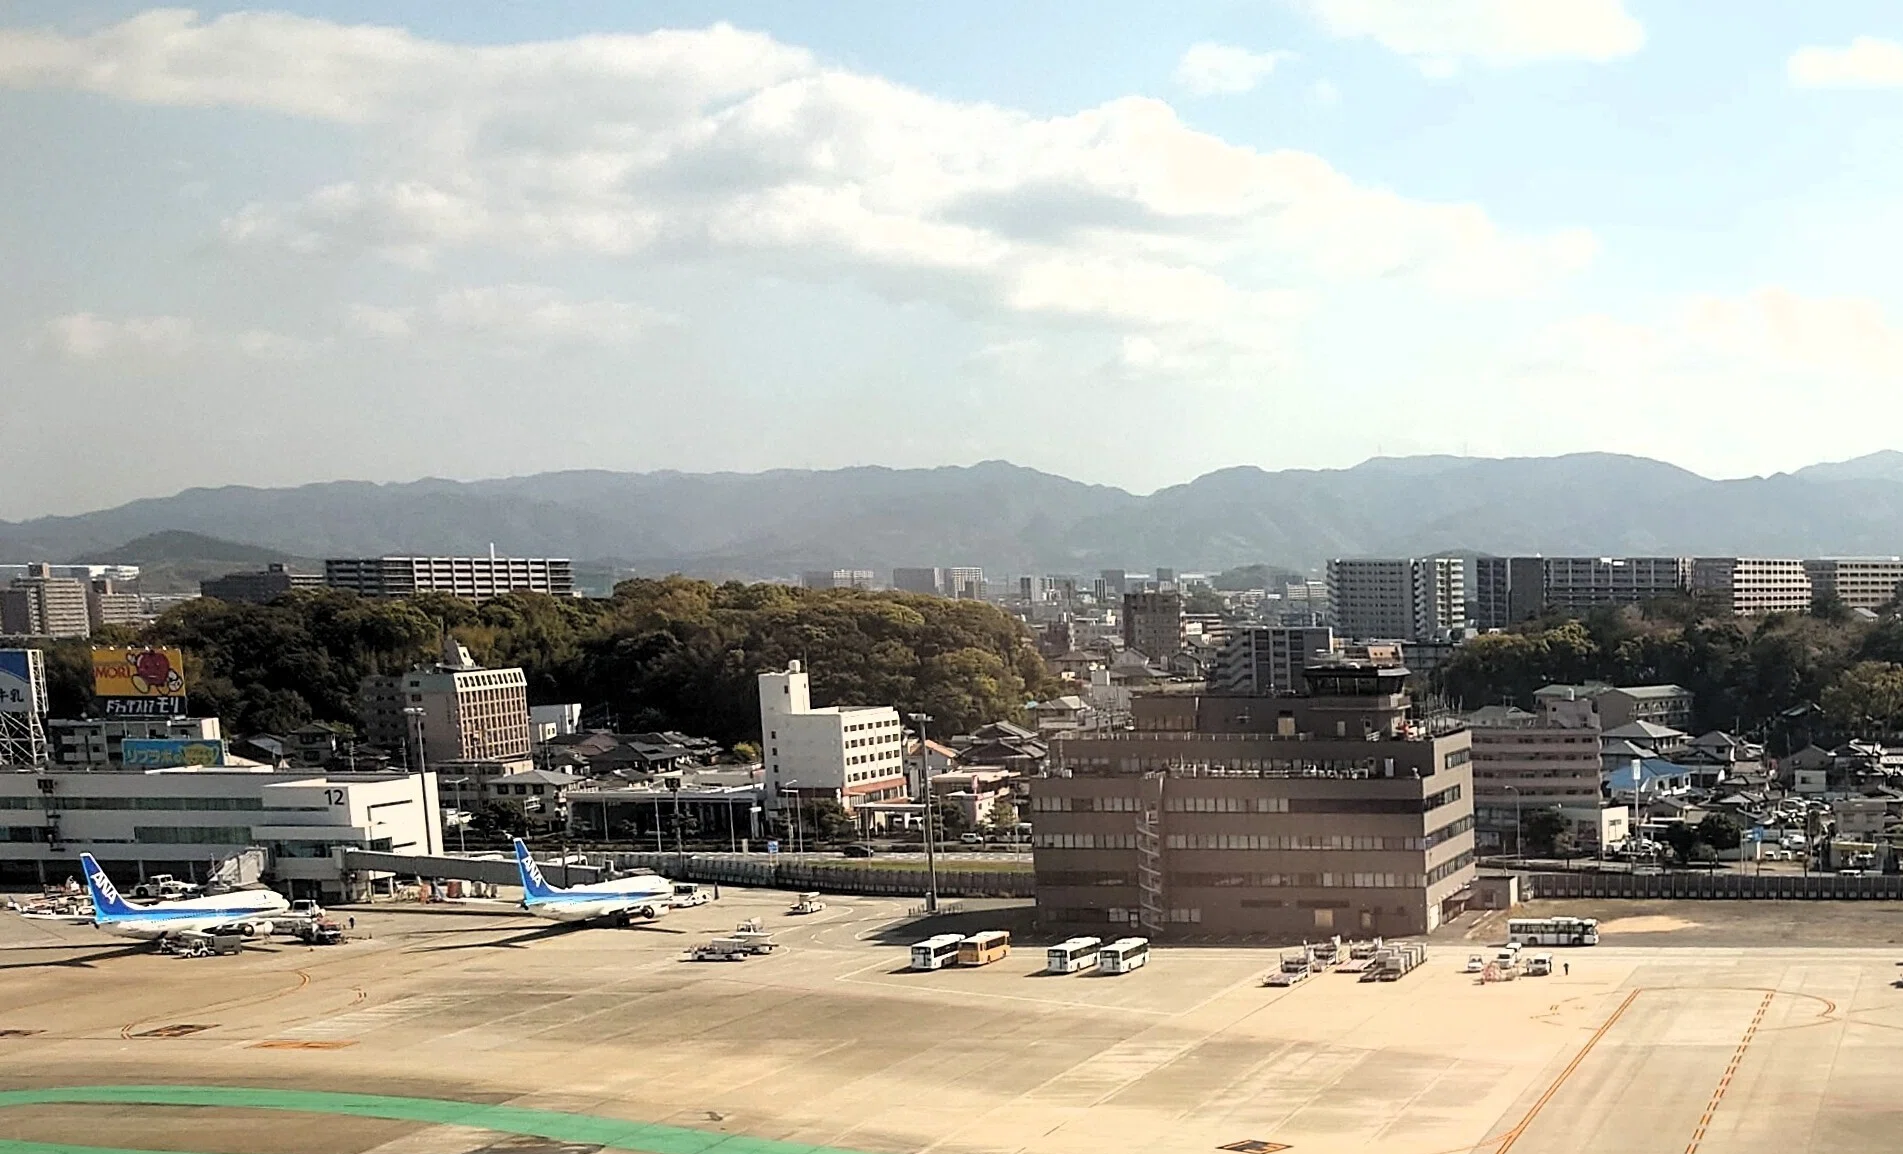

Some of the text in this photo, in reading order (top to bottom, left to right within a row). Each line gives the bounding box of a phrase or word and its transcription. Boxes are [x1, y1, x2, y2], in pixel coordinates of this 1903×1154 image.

[94, 665, 131, 679] MORI
[324, 789, 345, 805] 12
[521, 857, 542, 888] ANA
[90, 870, 117, 905] ANA
